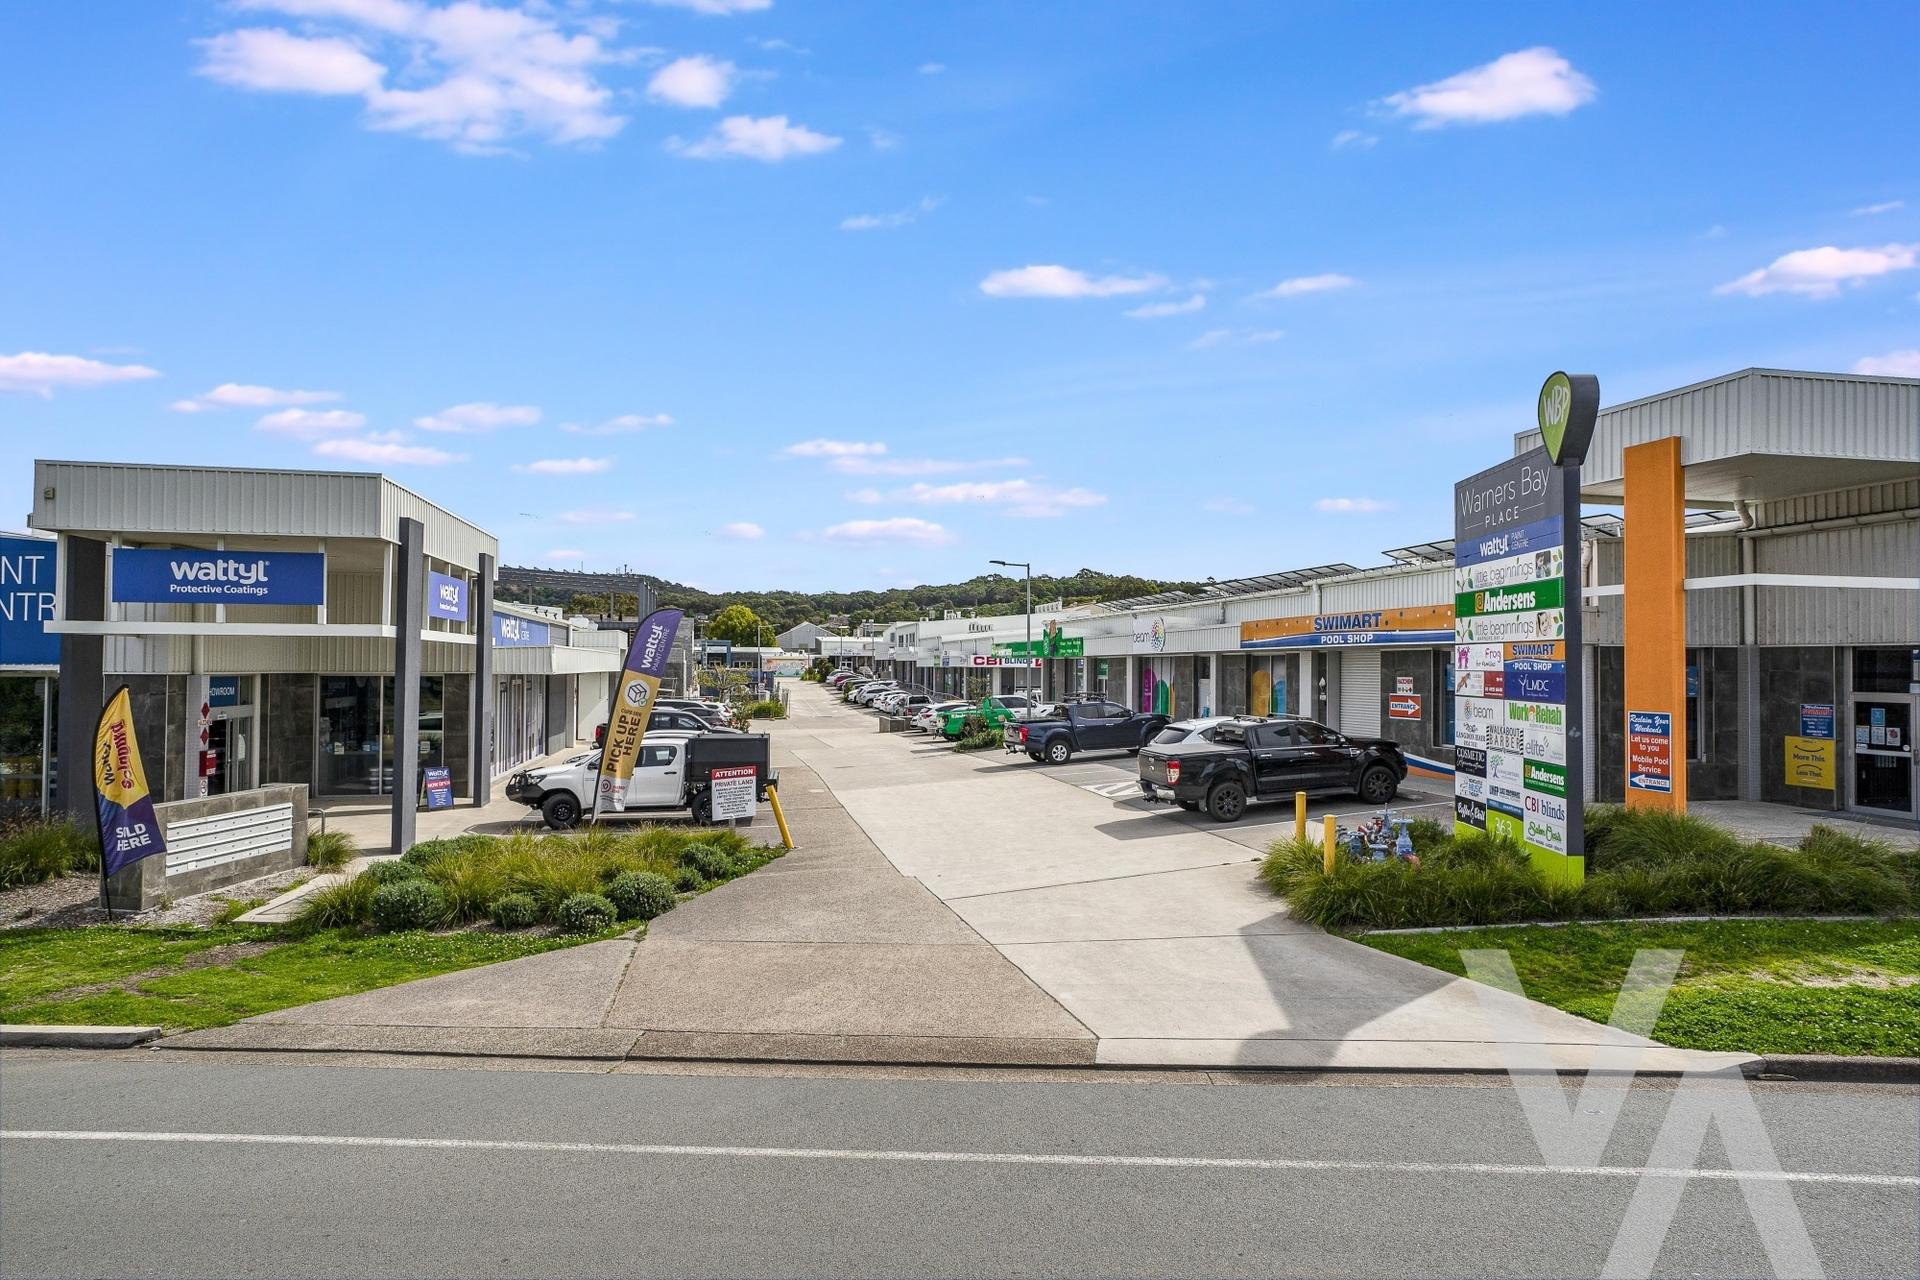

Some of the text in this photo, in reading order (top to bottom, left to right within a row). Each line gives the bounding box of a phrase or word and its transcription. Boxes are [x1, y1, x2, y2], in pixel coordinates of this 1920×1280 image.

[1543, 385, 1568, 427] WBP
[1460, 466, 1550, 517] Warners Bay
[1485, 506, 1519, 528] PLACE
[1480, 534, 1509, 557] wattyl
[170, 559, 268, 585] wattyl
[170, 584, 268, 596] Protective Coatings
[1484, 590, 1536, 613] Andersens
[500, 616, 520, 642] wattyl
[1314, 612, 1382, 632] SWIMART
[1490, 618, 1534, 640] beginnings
[641, 624, 663, 668] wattyl
[1321, 634, 1374, 644] POOL SHOP
[652, 628, 671, 671] PAINT CENTRE
[1513, 643, 1555, 655] SWIMART
[973, 656, 1002, 666] CBI
[1515, 662, 1553, 671] POOL SHOP
[1473, 703, 1494, 720] beam
[1509, 702, 1562, 726] Work Rehab
[1630, 714, 1669, 727] Reclaim Your
[1634, 723, 1663, 734] Weekends
[623, 716, 641, 756] HERE
[1489, 724, 1521, 738] WALKABOUT
[606, 739, 624, 773] PICK
[616, 714, 629, 735] UP
[1525, 739, 1545, 757] elite
[1630, 735, 1669, 745] Let us come
[1639, 743, 1660, 753] to you
[1456, 747, 1485, 763] COSMETIC
[1632, 754, 1669, 766] Mobile Pool
[1793, 753, 1810, 761] More
[715, 768, 754, 778] ATTENTION
[1531, 765, 1565, 786] Andersens
[1638, 764, 1662, 774] Service
[714, 779, 754, 788] PRIVATE LAND
[1638, 777, 1668, 787] ENTRANCE
[1524, 795, 1539, 813] CBI
[1541, 799, 1566, 821] blinds
[116, 833, 152, 852] HERE
